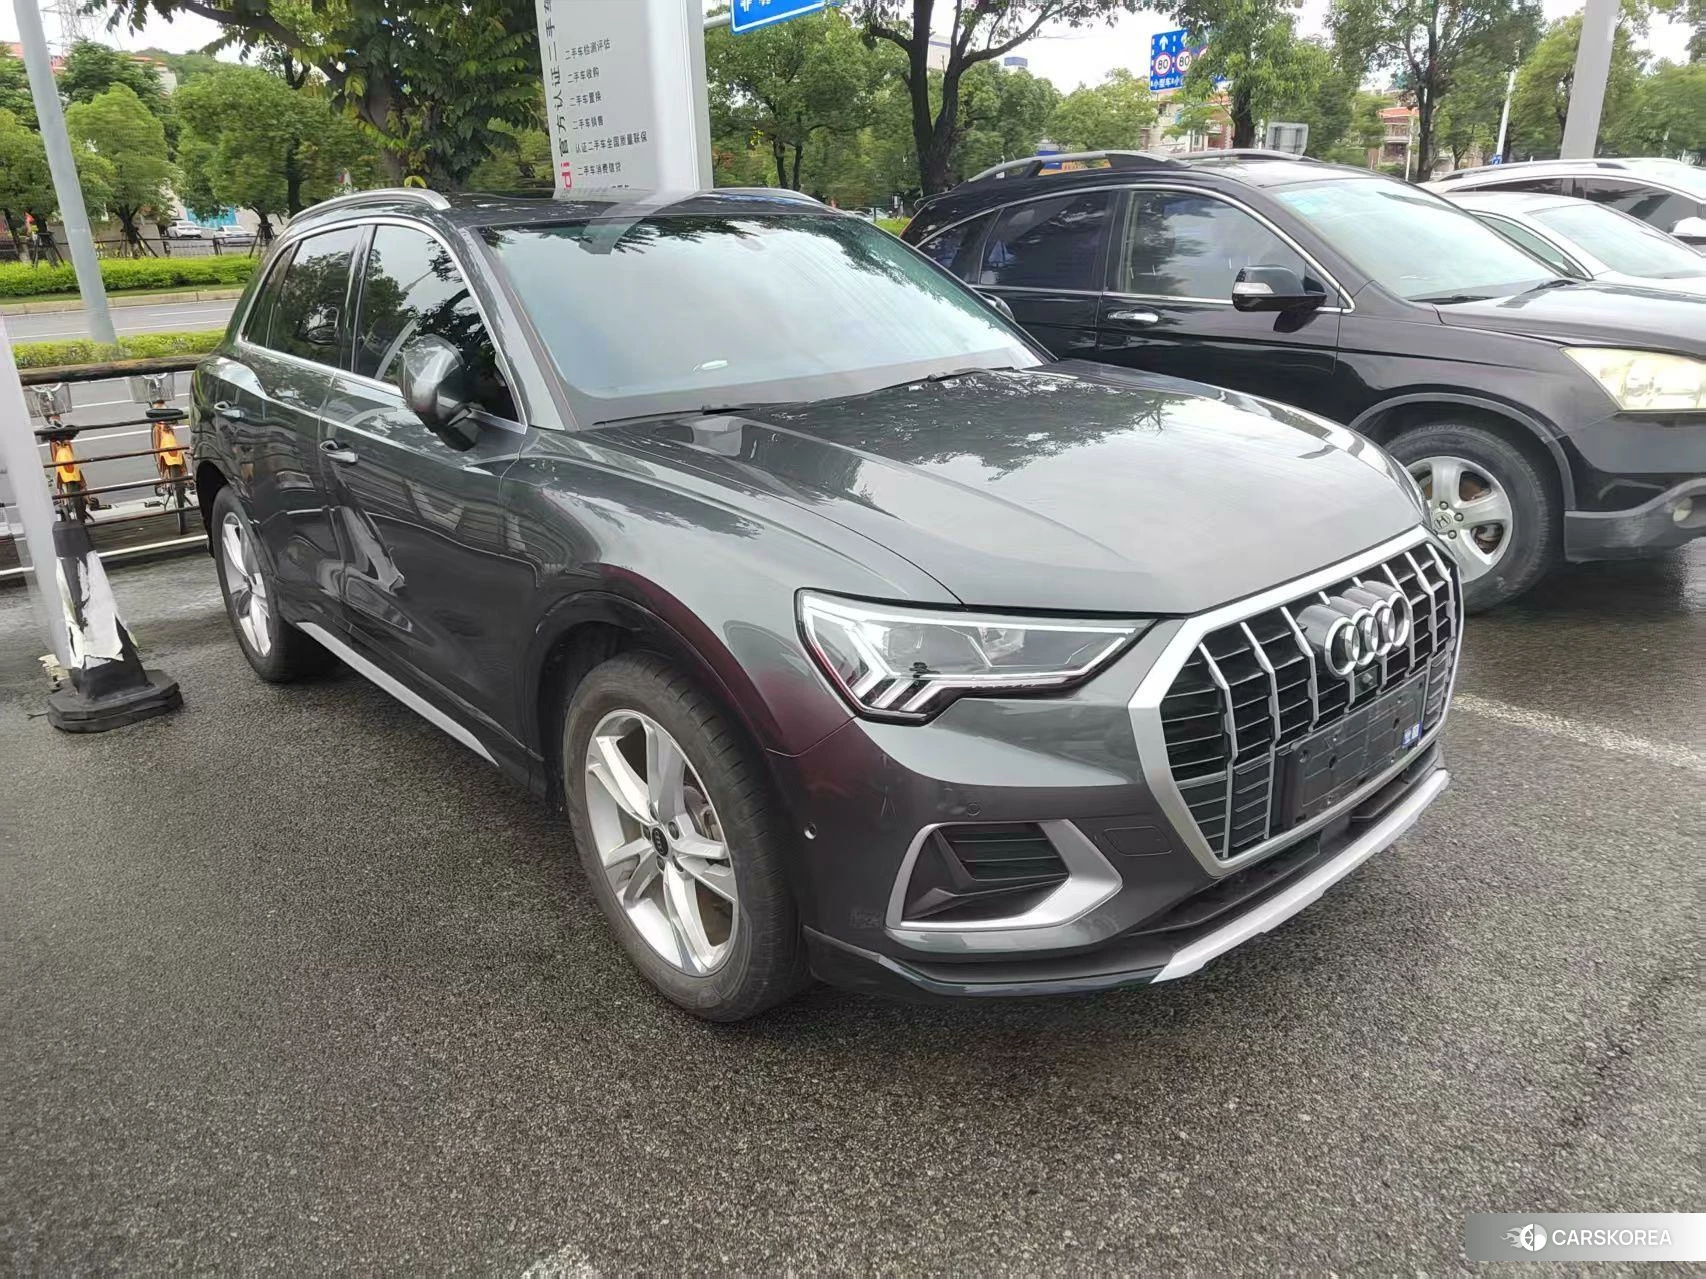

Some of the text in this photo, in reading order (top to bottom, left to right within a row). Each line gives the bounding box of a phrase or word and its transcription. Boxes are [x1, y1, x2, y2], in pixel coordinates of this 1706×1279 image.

[565, 38, 611, 60] 二手车检测评估
[1158, 59, 1169, 70] 80
[1178, 55, 1190, 67] 80
[567, 67, 600, 84] 二手车收购
[569, 90, 602, 107] 二手车置换
[572, 115, 604, 130] 二手车销售
[575, 131, 648, 154] 认证二手车全国质量联保
[577, 161, 622, 176] 二手车消费信贷
